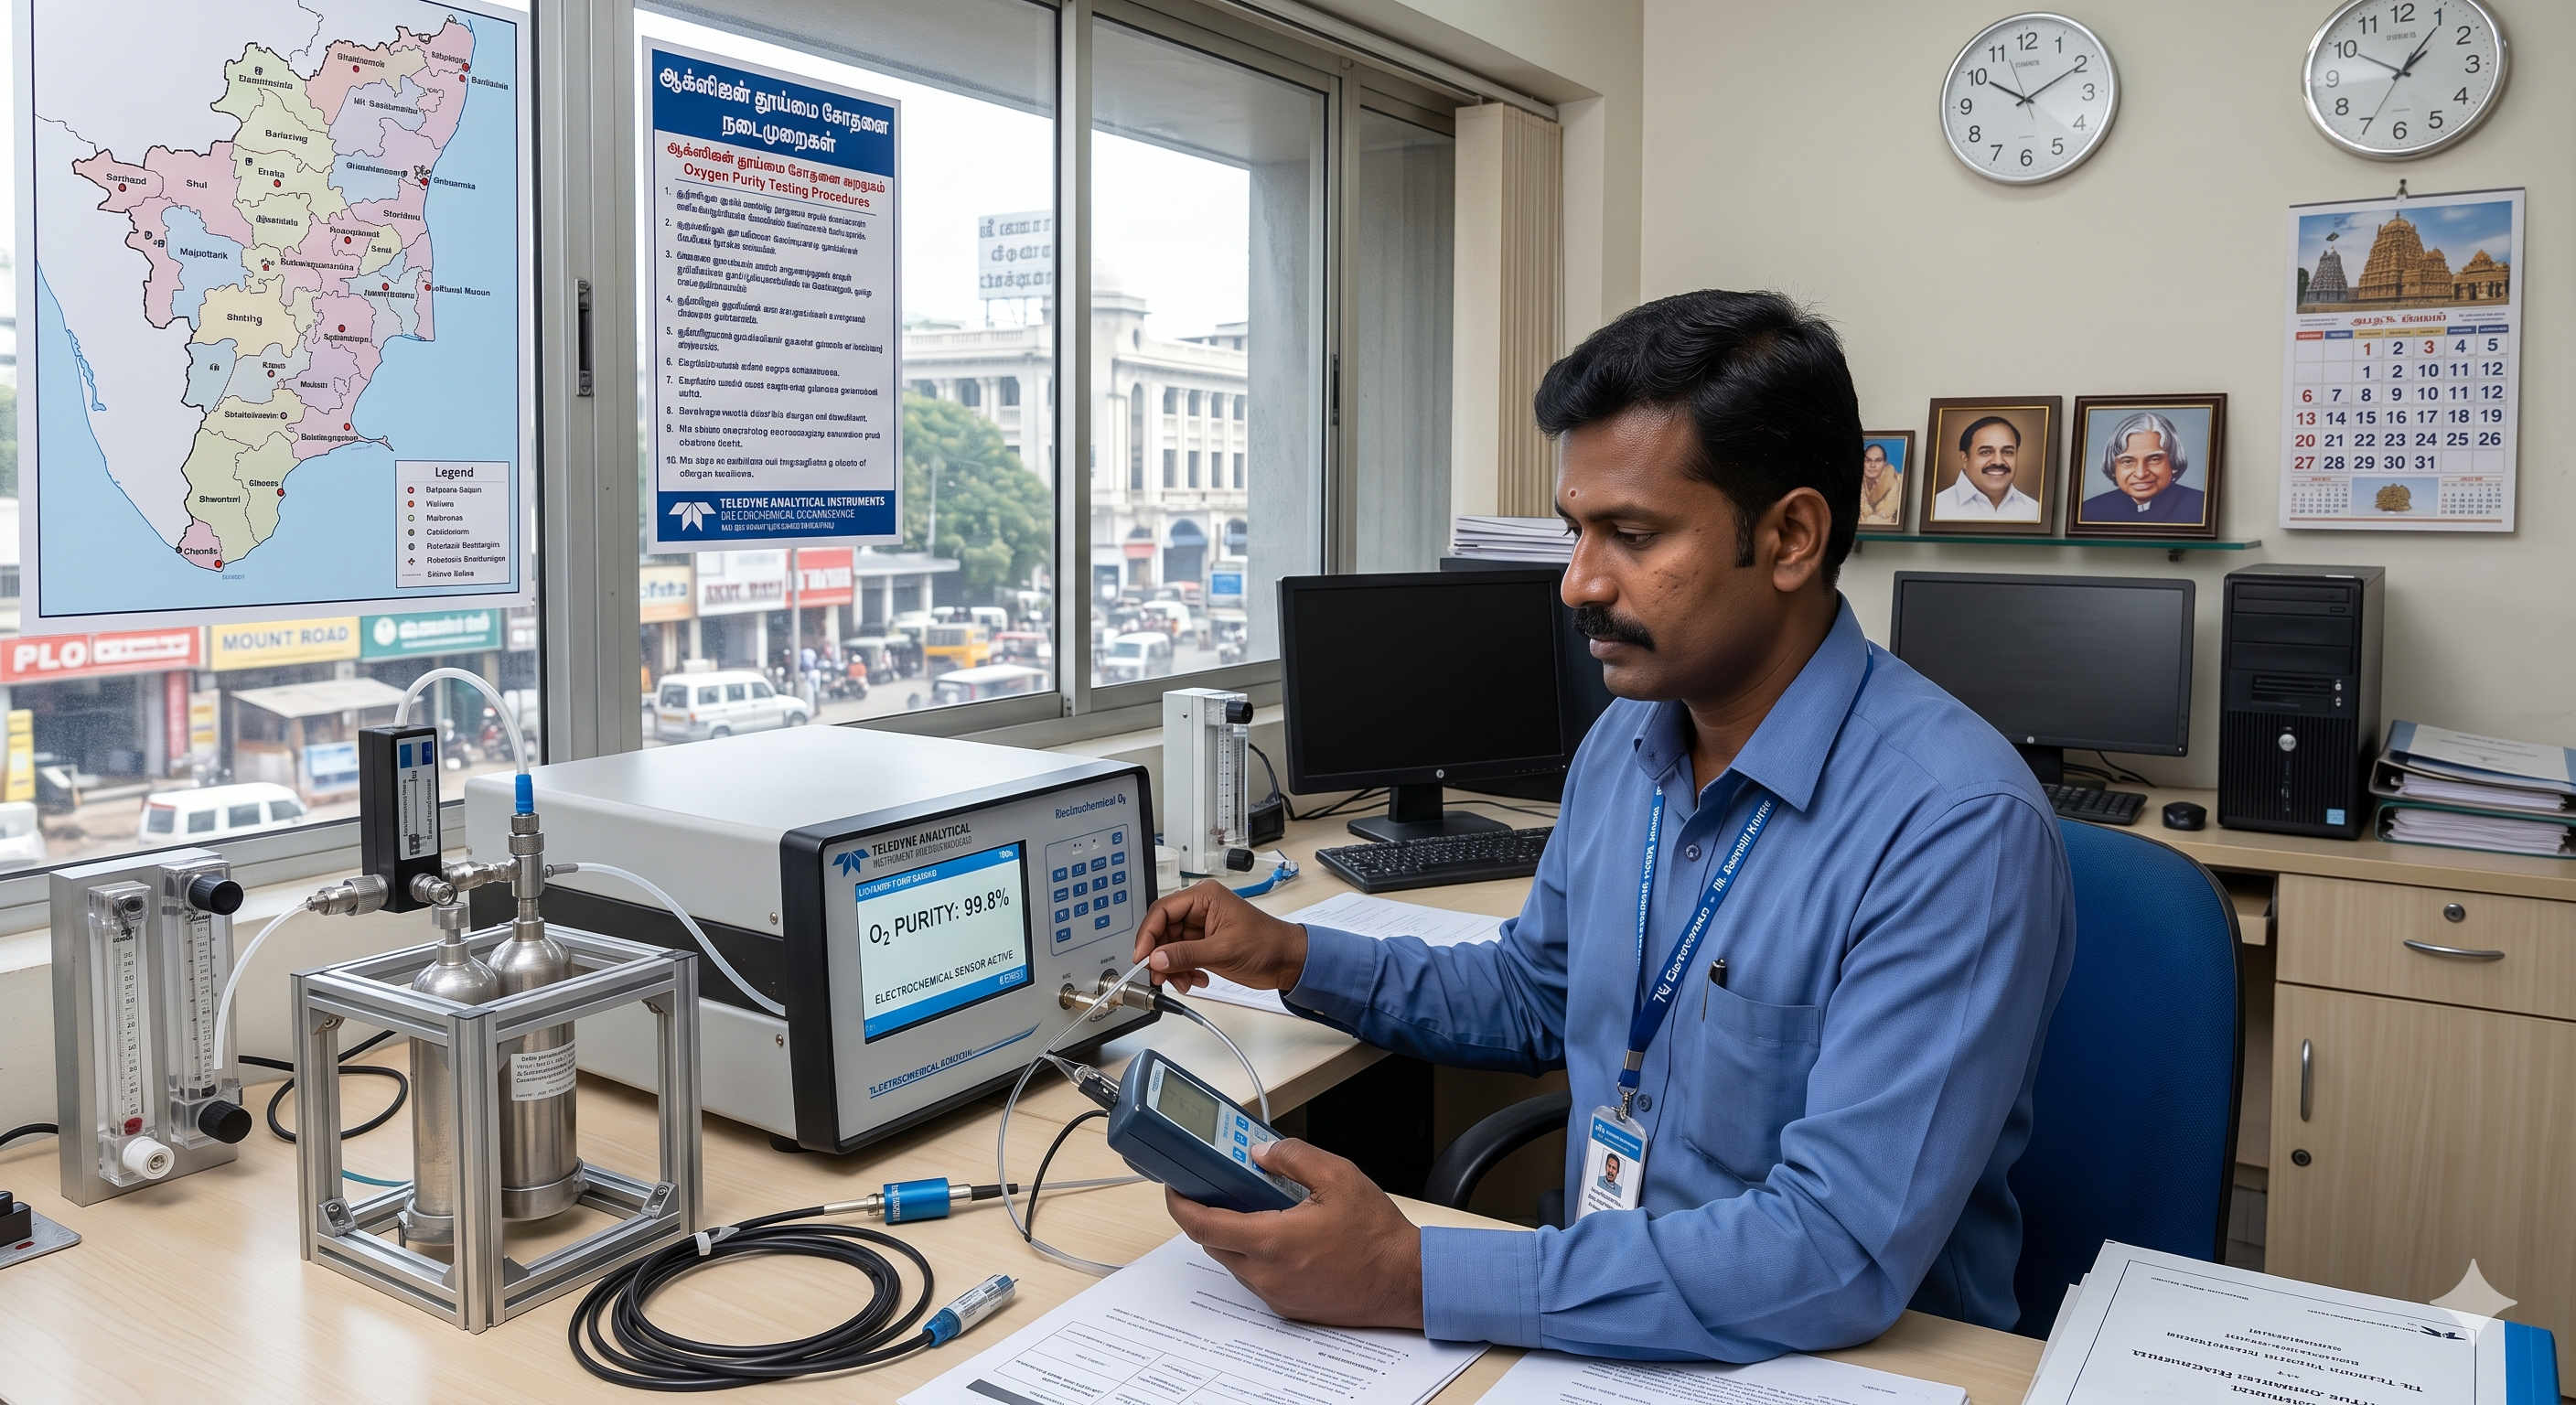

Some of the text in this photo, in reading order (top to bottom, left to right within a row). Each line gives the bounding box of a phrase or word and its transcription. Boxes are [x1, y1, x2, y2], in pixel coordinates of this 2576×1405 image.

[2390, 3, 2416, 24] 12
[2434, 7, 2442, 26] 1
[2358, 15, 2377, 35] 11
[2016, 32, 2038, 51] 12
[2456, 26, 2472, 46] 2
[1989, 44, 2004, 63] 11
[2055, 37, 2062, 54] 1
[2334, 39, 2357, 59] 10
[2074, 55, 2088, 74] 2
[2464, 54, 2481, 74] 3
[1967, 68, 1987, 87] 10
[2325, 70, 2339, 88] 9
[2082, 83, 2095, 101] 3
[2453, 86, 2469, 105] 4
[1959, 98, 1972, 115] 9
[2335, 97, 2349, 116] 8
[2073, 114, 2087, 132] 4
[2359, 117, 2374, 135] 7
[2429, 110, 2443, 129] 5
[1969, 125, 1981, 143] 8
[2392, 121, 2407, 140] 6
[1991, 144, 2002, 162] 7
[2051, 137, 2064, 156] 5
[2020, 149, 2033, 166] 6
[683, 162, 870, 208] Oxygen Purity Testing Procedures
[665, 219, 672, 227] 2.
[665, 251, 672, 259] 3.
[666, 295, 673, 304] 4.
[2363, 338, 2498, 356] 1 2 3 4 5
[2363, 362, 2504, 379] 1 2 10 11 12
[667, 376, 673, 384] 7.
[2302, 385, 2504, 402] 6 7 8 9 10 11 12
[2297, 409, 2503, 425] 13 14 15 16 17 18 19
[2295, 432, 2502, 447] 20 21 22 23 24 25 26
[2294, 456, 2435, 469] 27 28 29 30 31
[435, 467, 474, 480] Legend
[720, 496, 886, 509] TELEDYNE ANALYTICAL INSTRUMENTS
[222, 626, 349, 651] MOUNT ROAD
[872, 835, 918, 856] TELEDYNE
[919, 823, 971, 844] ANALYTICAL
[895, 902, 960, 938] PURITY:
[964, 887, 1010, 917] 99.8%
[954, 959, 986, 978] SENSOR
